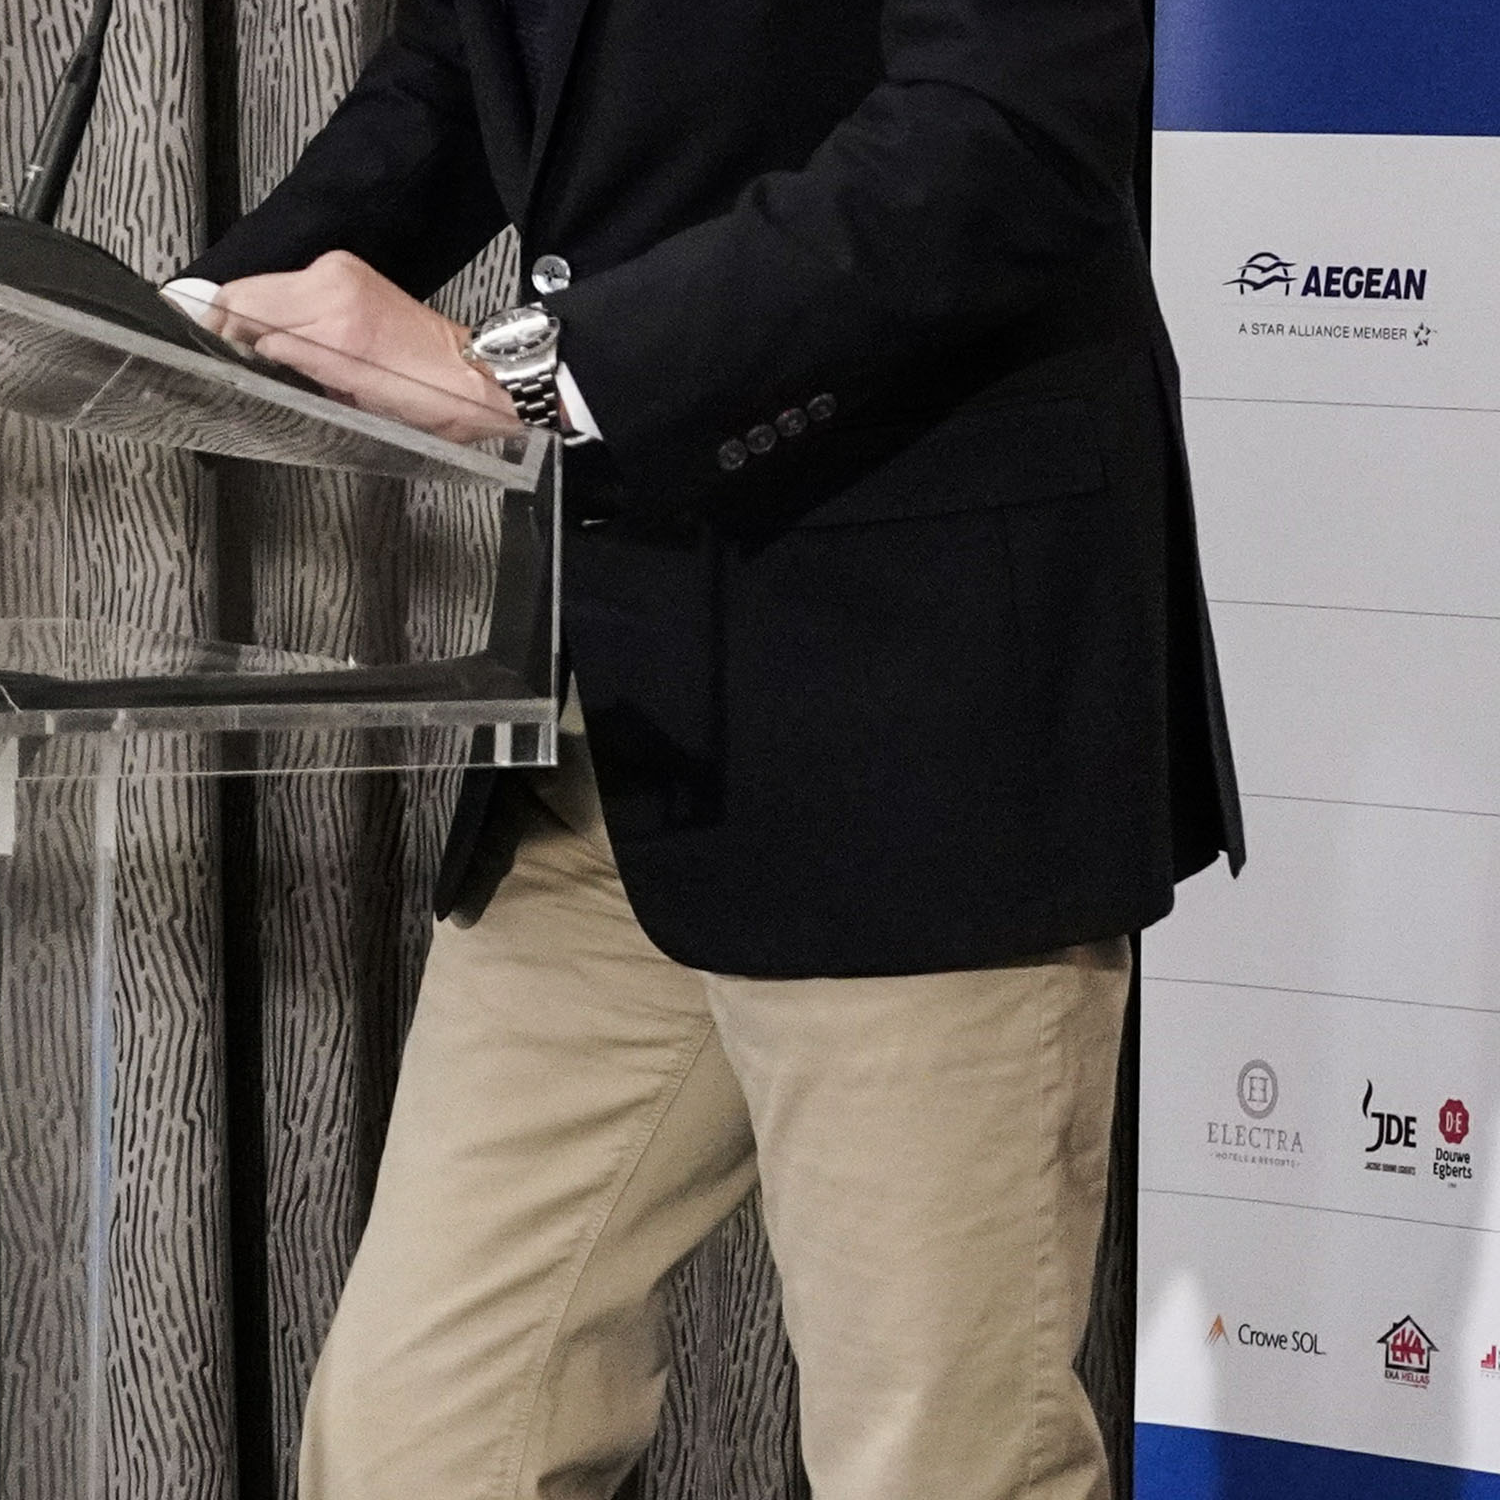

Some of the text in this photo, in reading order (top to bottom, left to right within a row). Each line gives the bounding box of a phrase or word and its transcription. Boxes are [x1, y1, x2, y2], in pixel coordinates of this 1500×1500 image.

[1301, 266, 1427, 300] AEGEAN
[1238, 323, 1408, 340] A STAR ALLIANCE MEMBER
[1207, 1122, 1304, 1153] ELECTRA
[1365, 1112, 1417, 1152] JDE
[1436, 1147, 1471, 1164] Douwe
[1433, 1162, 1473, 1180] Egberts
[1238, 1323, 1287, 1350] Crowe
